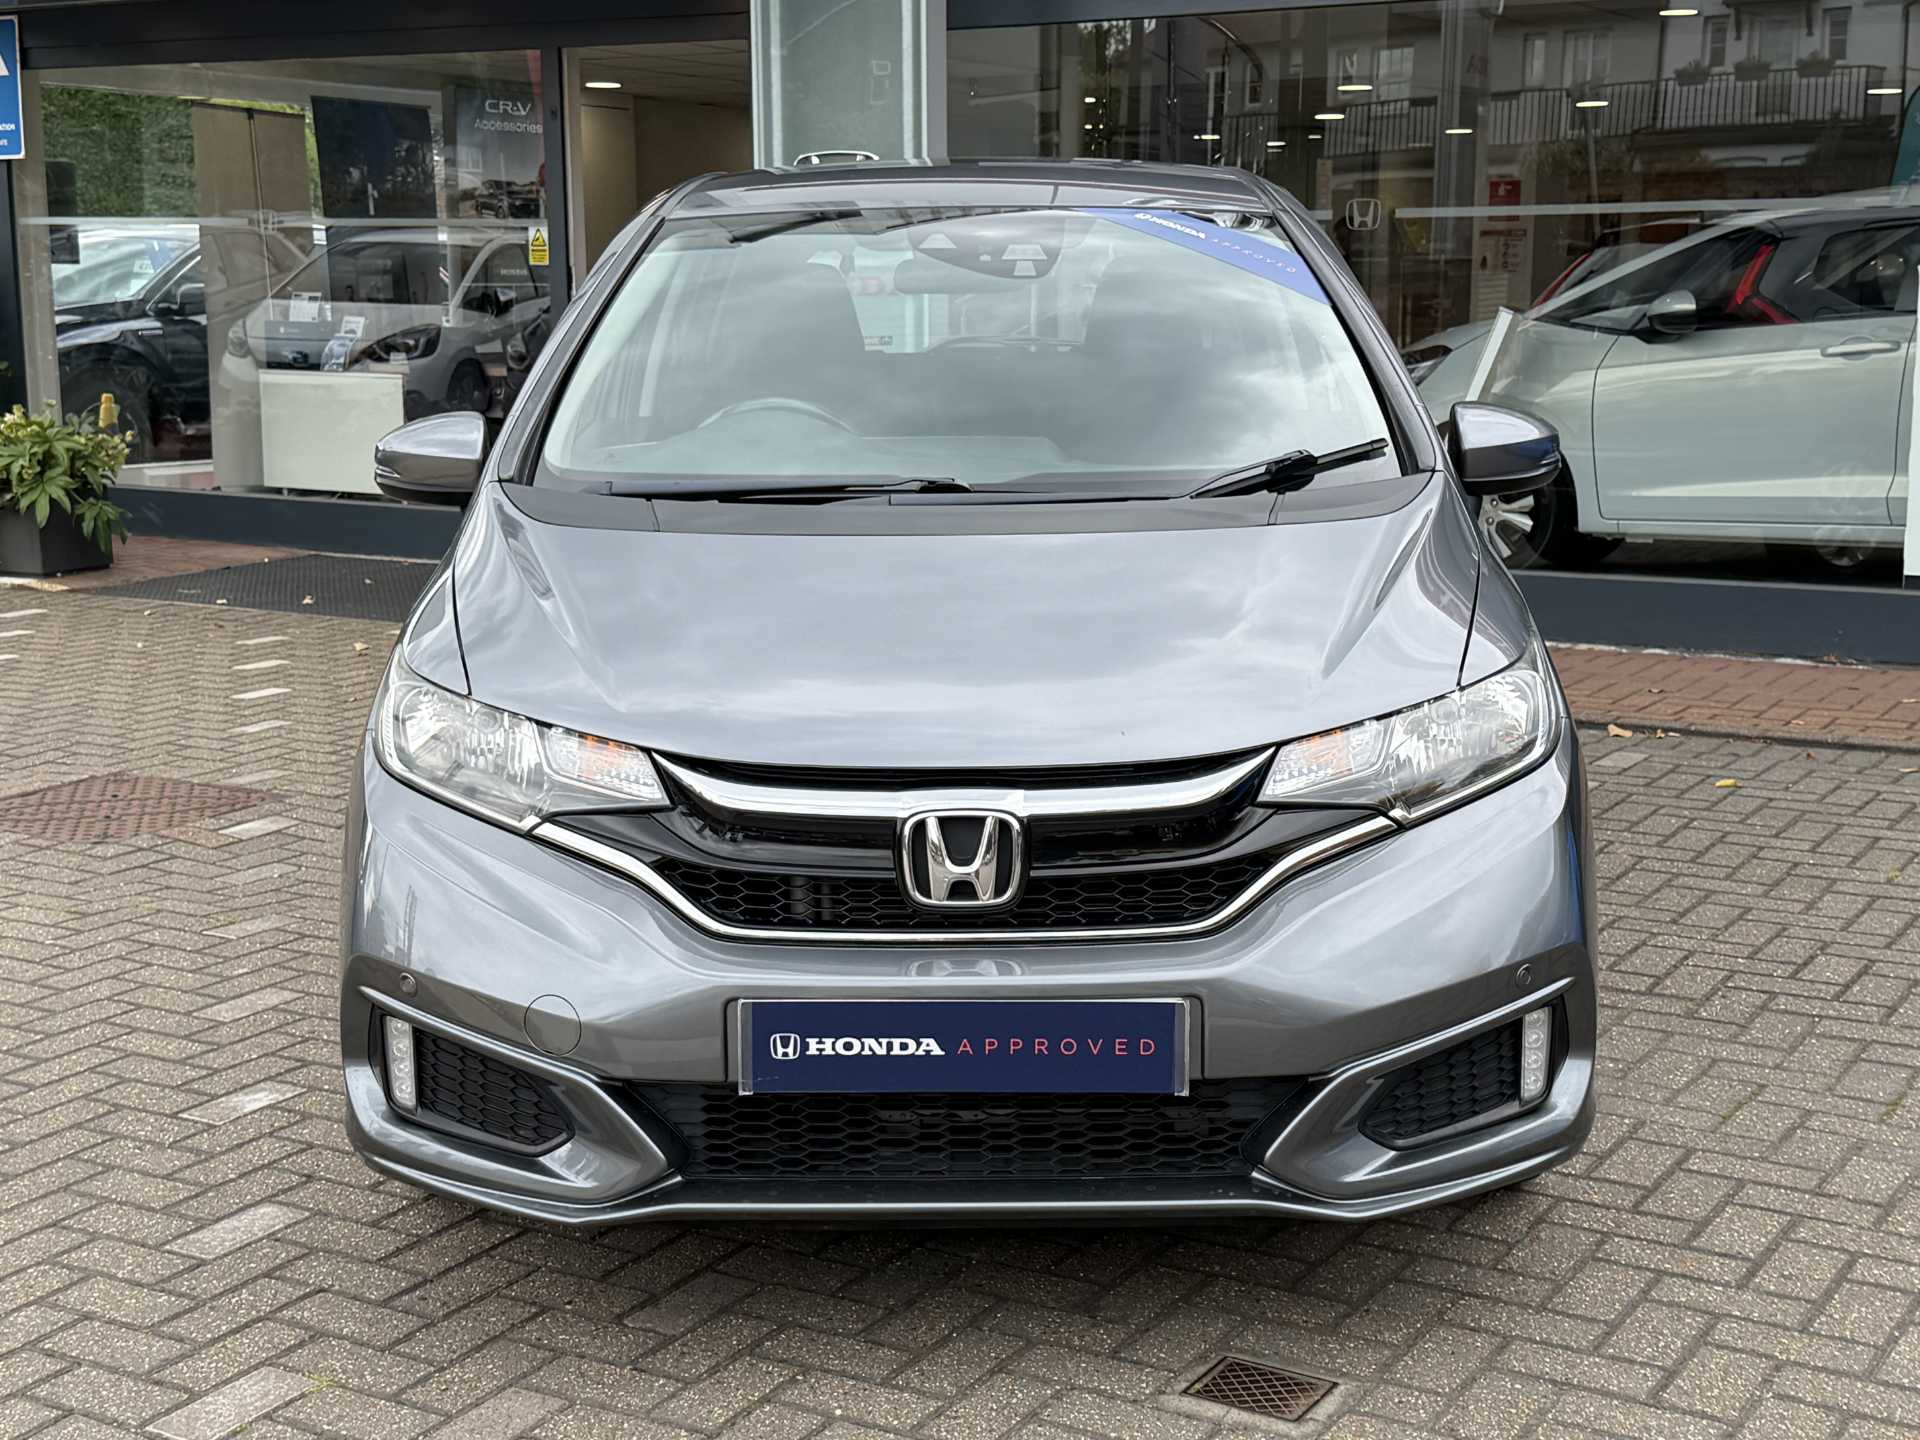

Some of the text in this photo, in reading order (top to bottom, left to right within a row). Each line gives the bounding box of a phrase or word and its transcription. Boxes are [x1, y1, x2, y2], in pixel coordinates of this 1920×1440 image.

[474, 119, 543, 134] Accessories
[1149, 215, 1206, 240] HONDA
[805, 1037, 946, 1056] HONDA
[957, 1038, 1156, 1056] APPROVED
